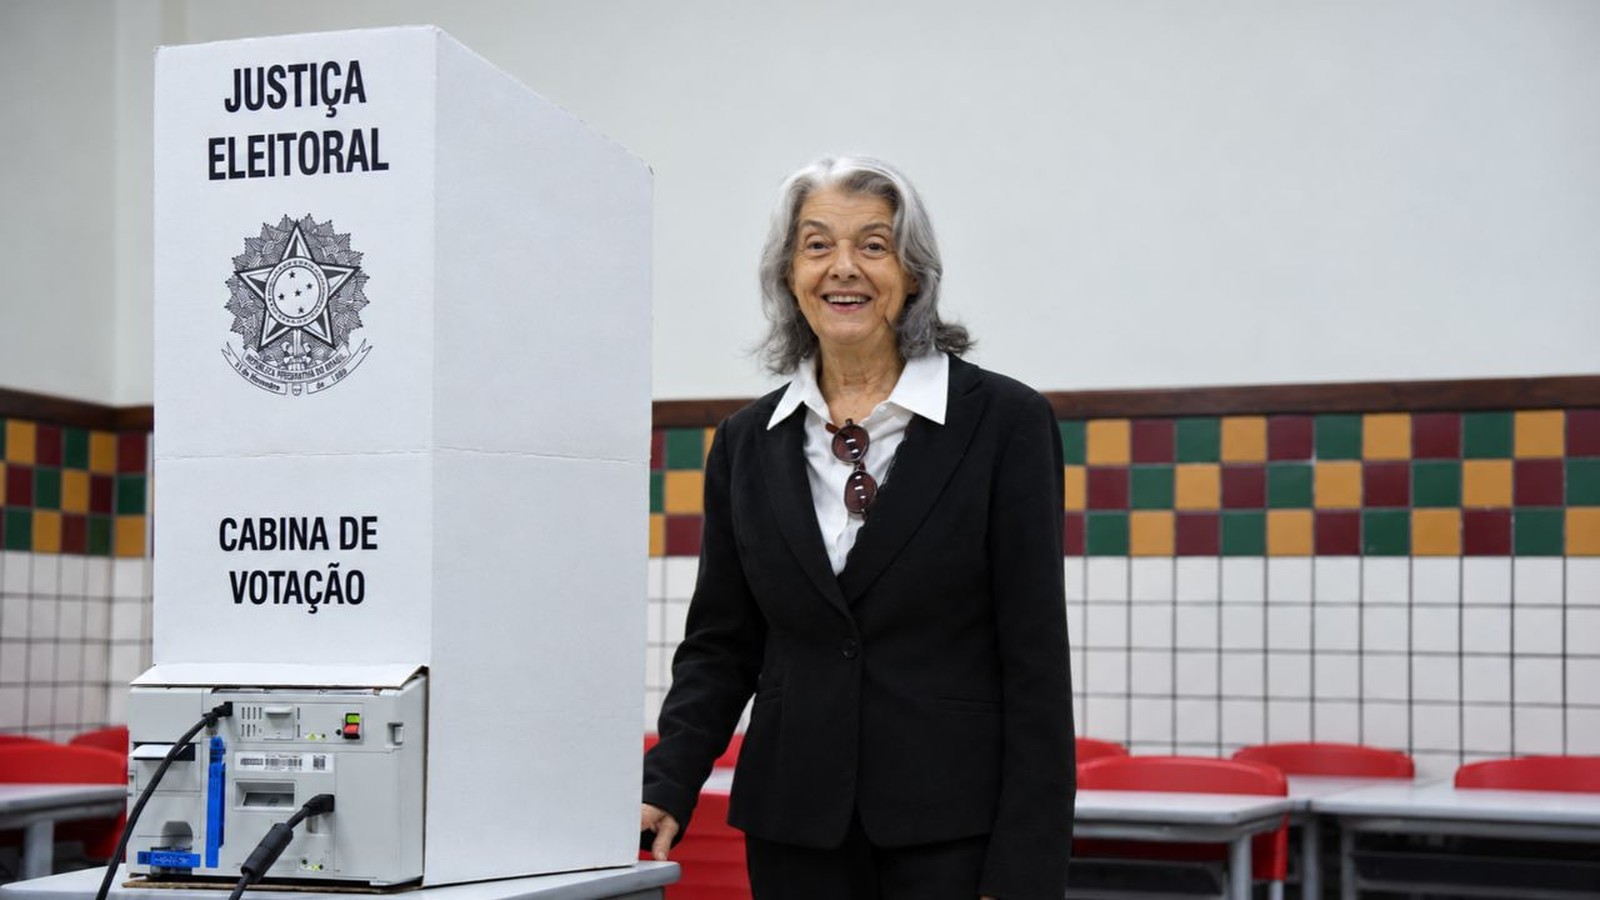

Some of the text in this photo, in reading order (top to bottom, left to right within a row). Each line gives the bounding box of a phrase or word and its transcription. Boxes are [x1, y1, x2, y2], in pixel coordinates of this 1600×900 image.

[224, 60, 367, 118] JUSTIÇA
[208, 128, 389, 180] ELEITORAL
[219, 516, 378, 552] CABINA DE
[229, 562, 365, 614] VOTAÇÃO
